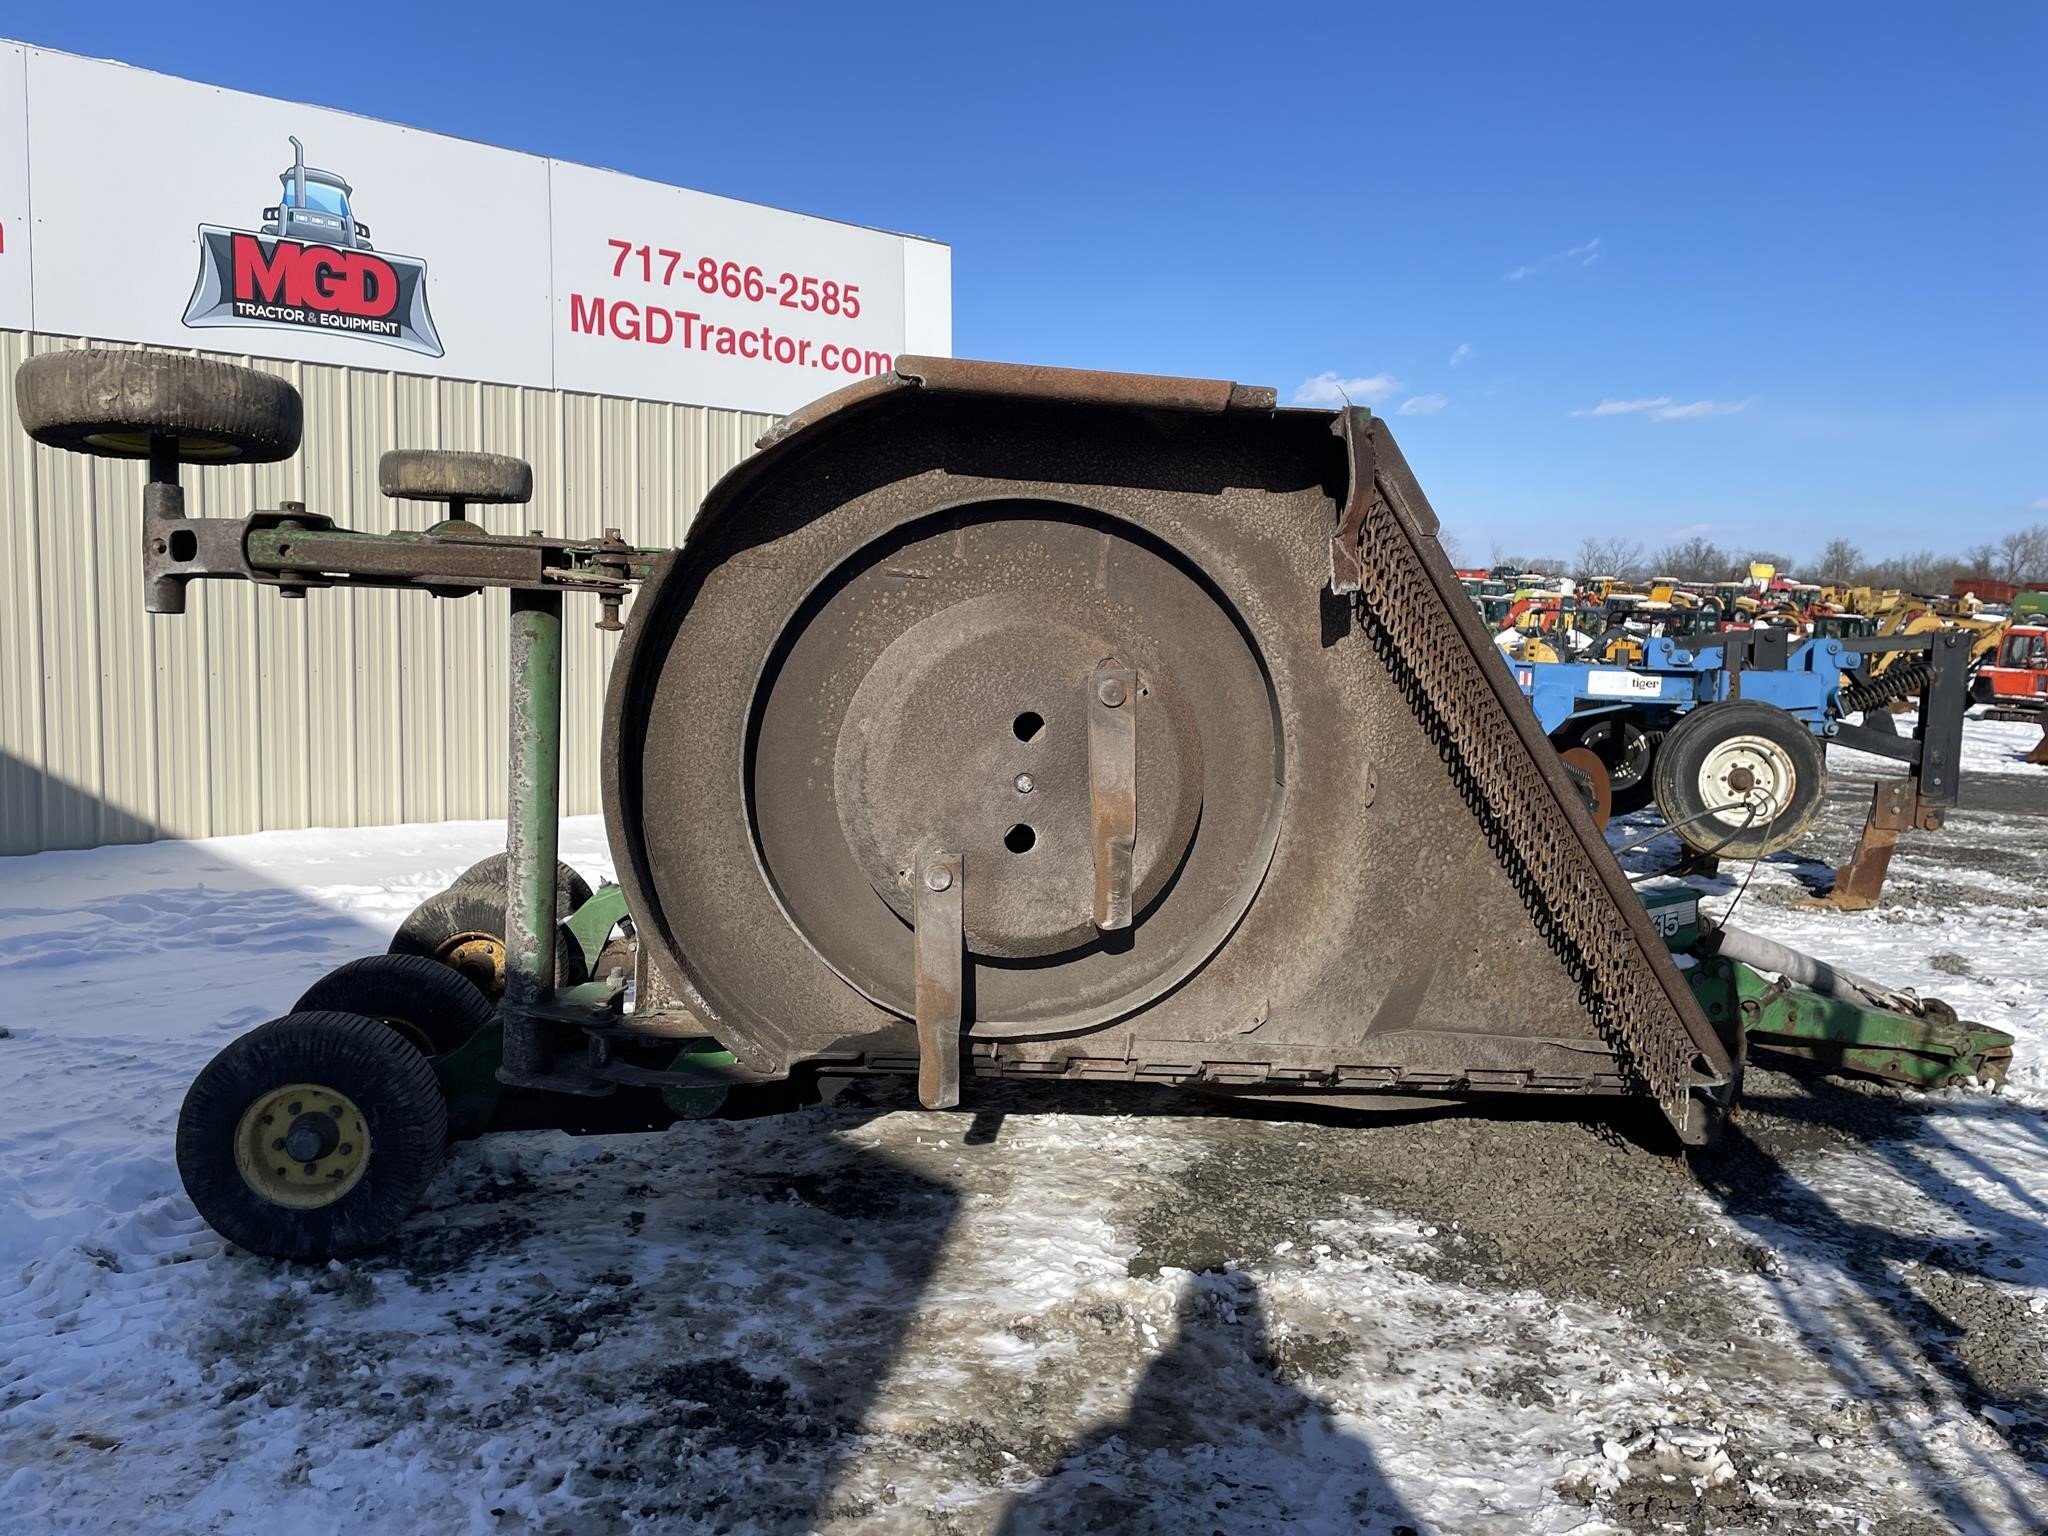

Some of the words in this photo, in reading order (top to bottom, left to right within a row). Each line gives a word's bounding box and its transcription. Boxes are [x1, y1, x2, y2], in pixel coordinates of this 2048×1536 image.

[233, 233, 399, 318] MGD
[607, 238, 861, 319] 717-866-2585
[236, 301, 305, 322] TRACTOR
[307, 311, 317, 324] &
[320, 313, 398, 335] EQUIPMENT
[570, 293, 892, 376] MGDTractor.com
[1632, 676, 1660, 690] tiger
